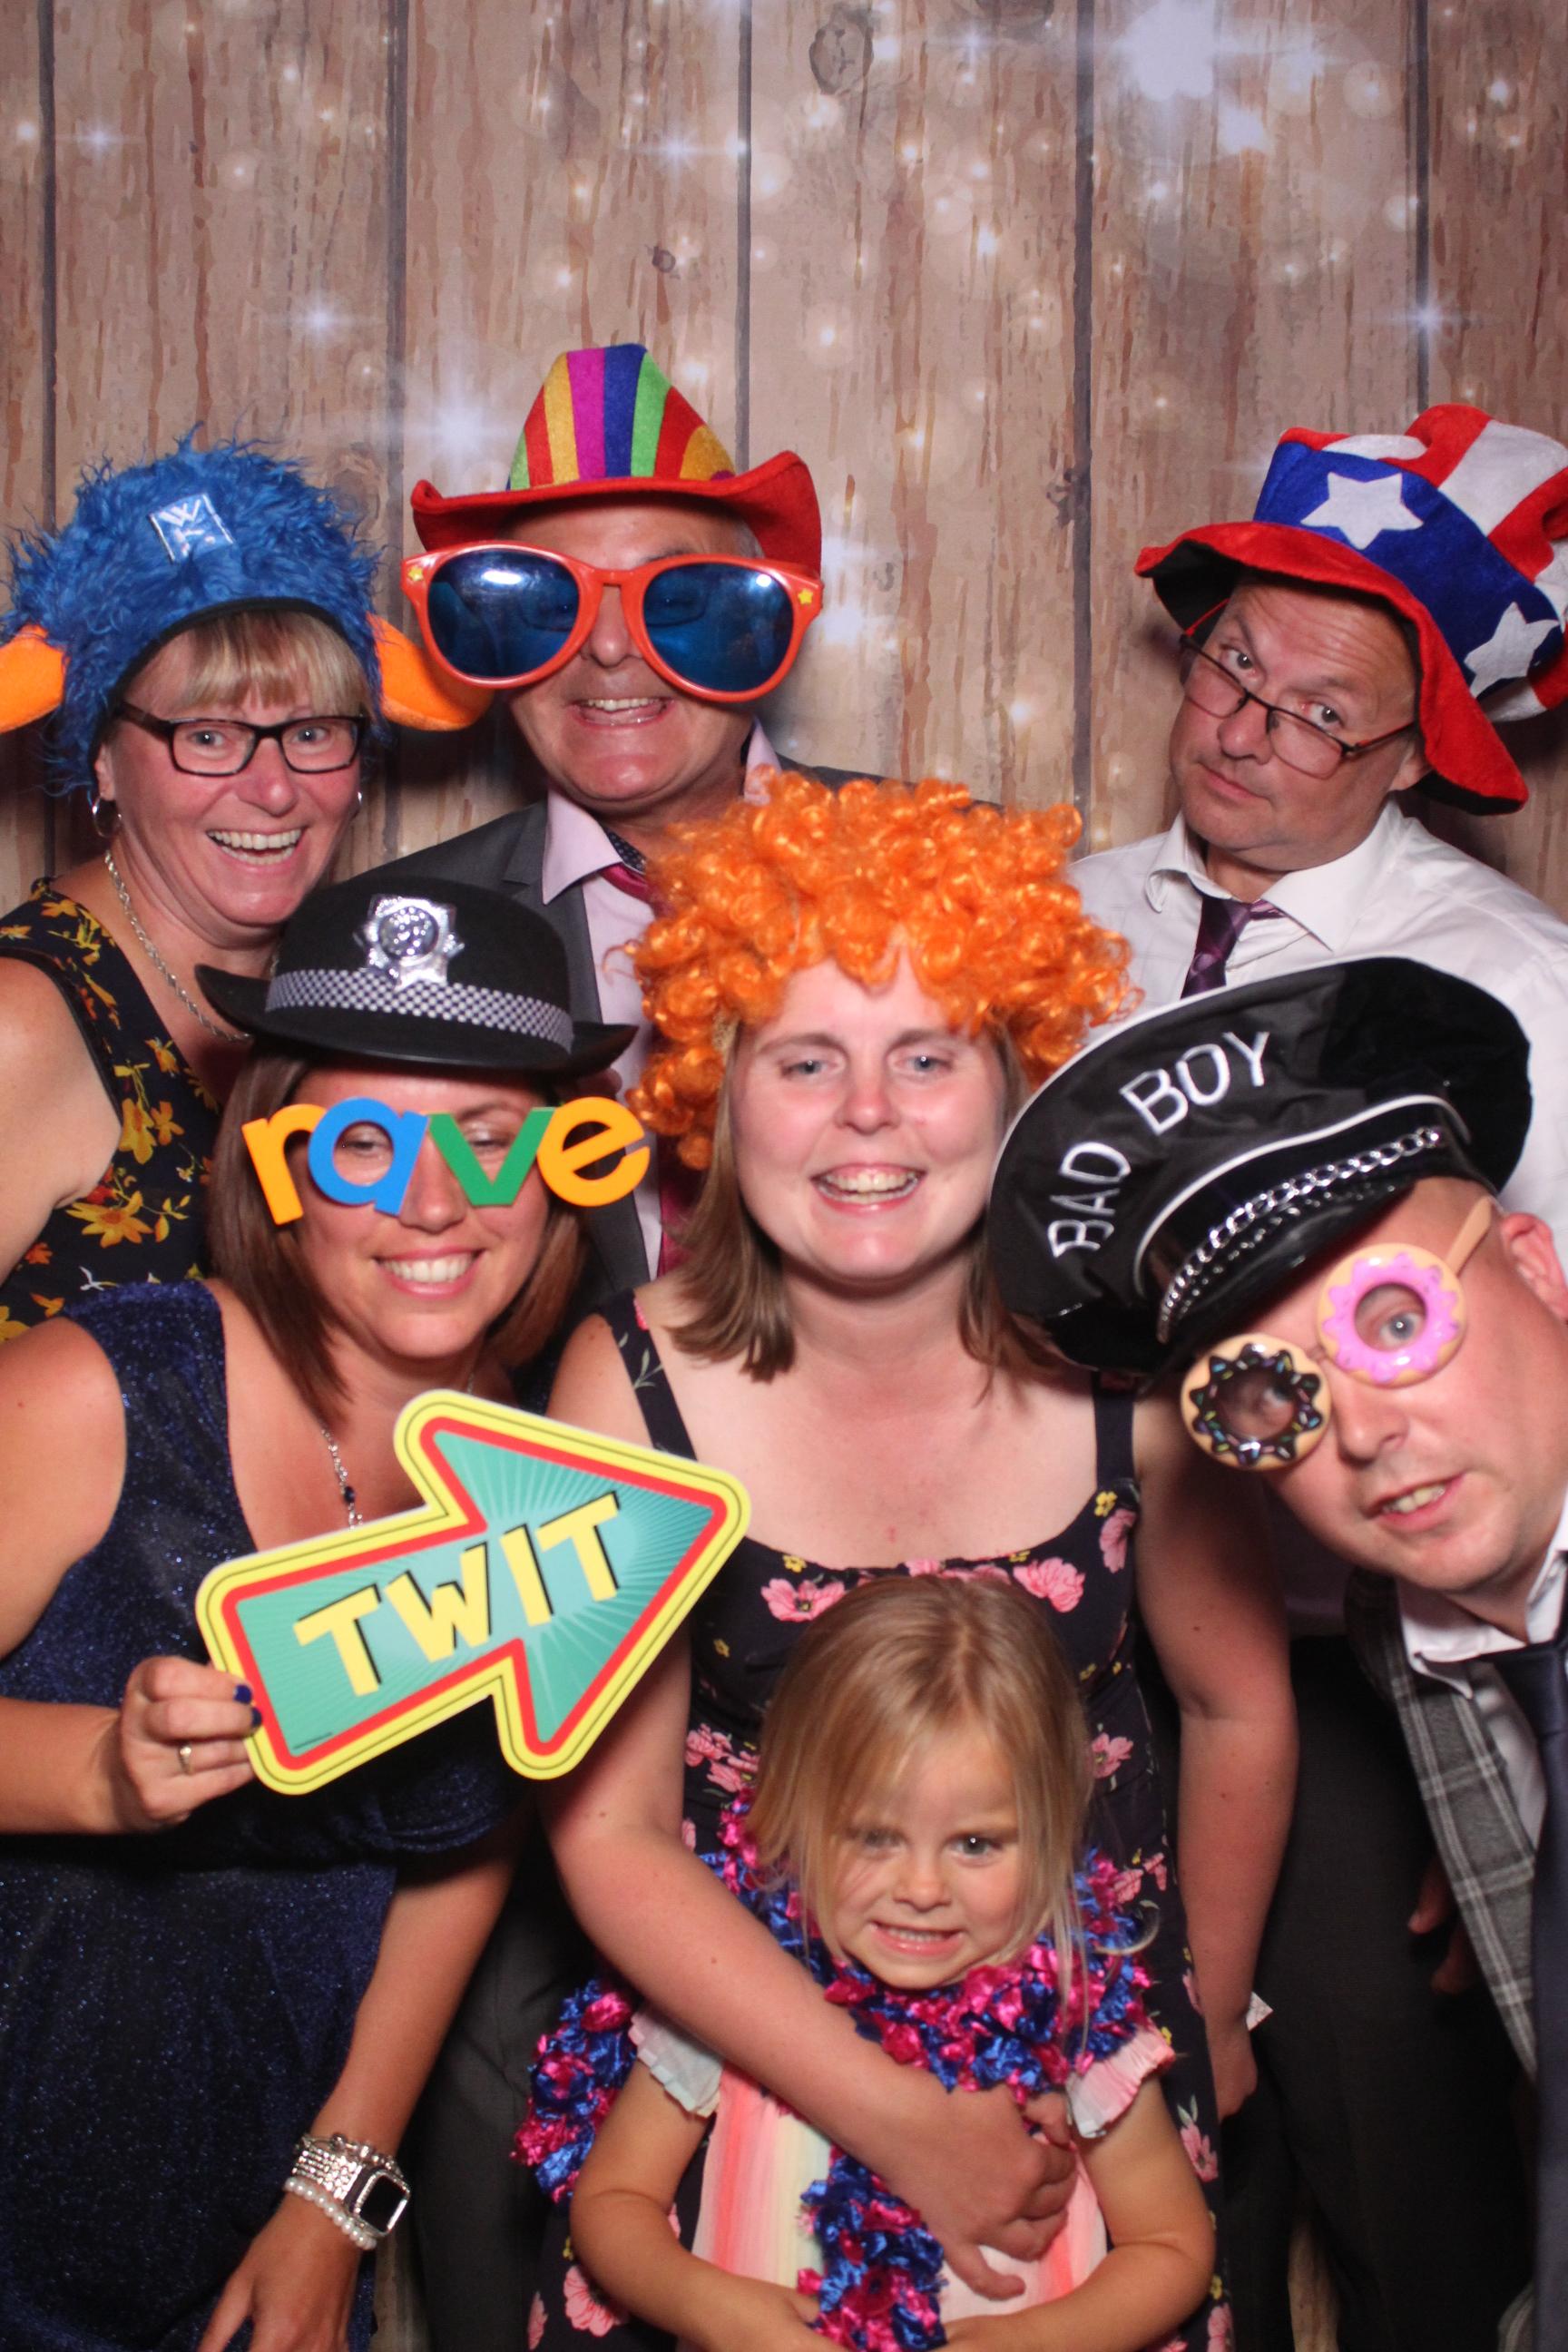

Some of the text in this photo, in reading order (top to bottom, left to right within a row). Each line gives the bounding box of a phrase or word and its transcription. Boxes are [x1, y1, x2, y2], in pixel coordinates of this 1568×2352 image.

[241, 1096, 651, 1225] rave
[1048, 1032, 1270, 1258] BAD BOY
[292, 1490, 620, 1696] TWIT
